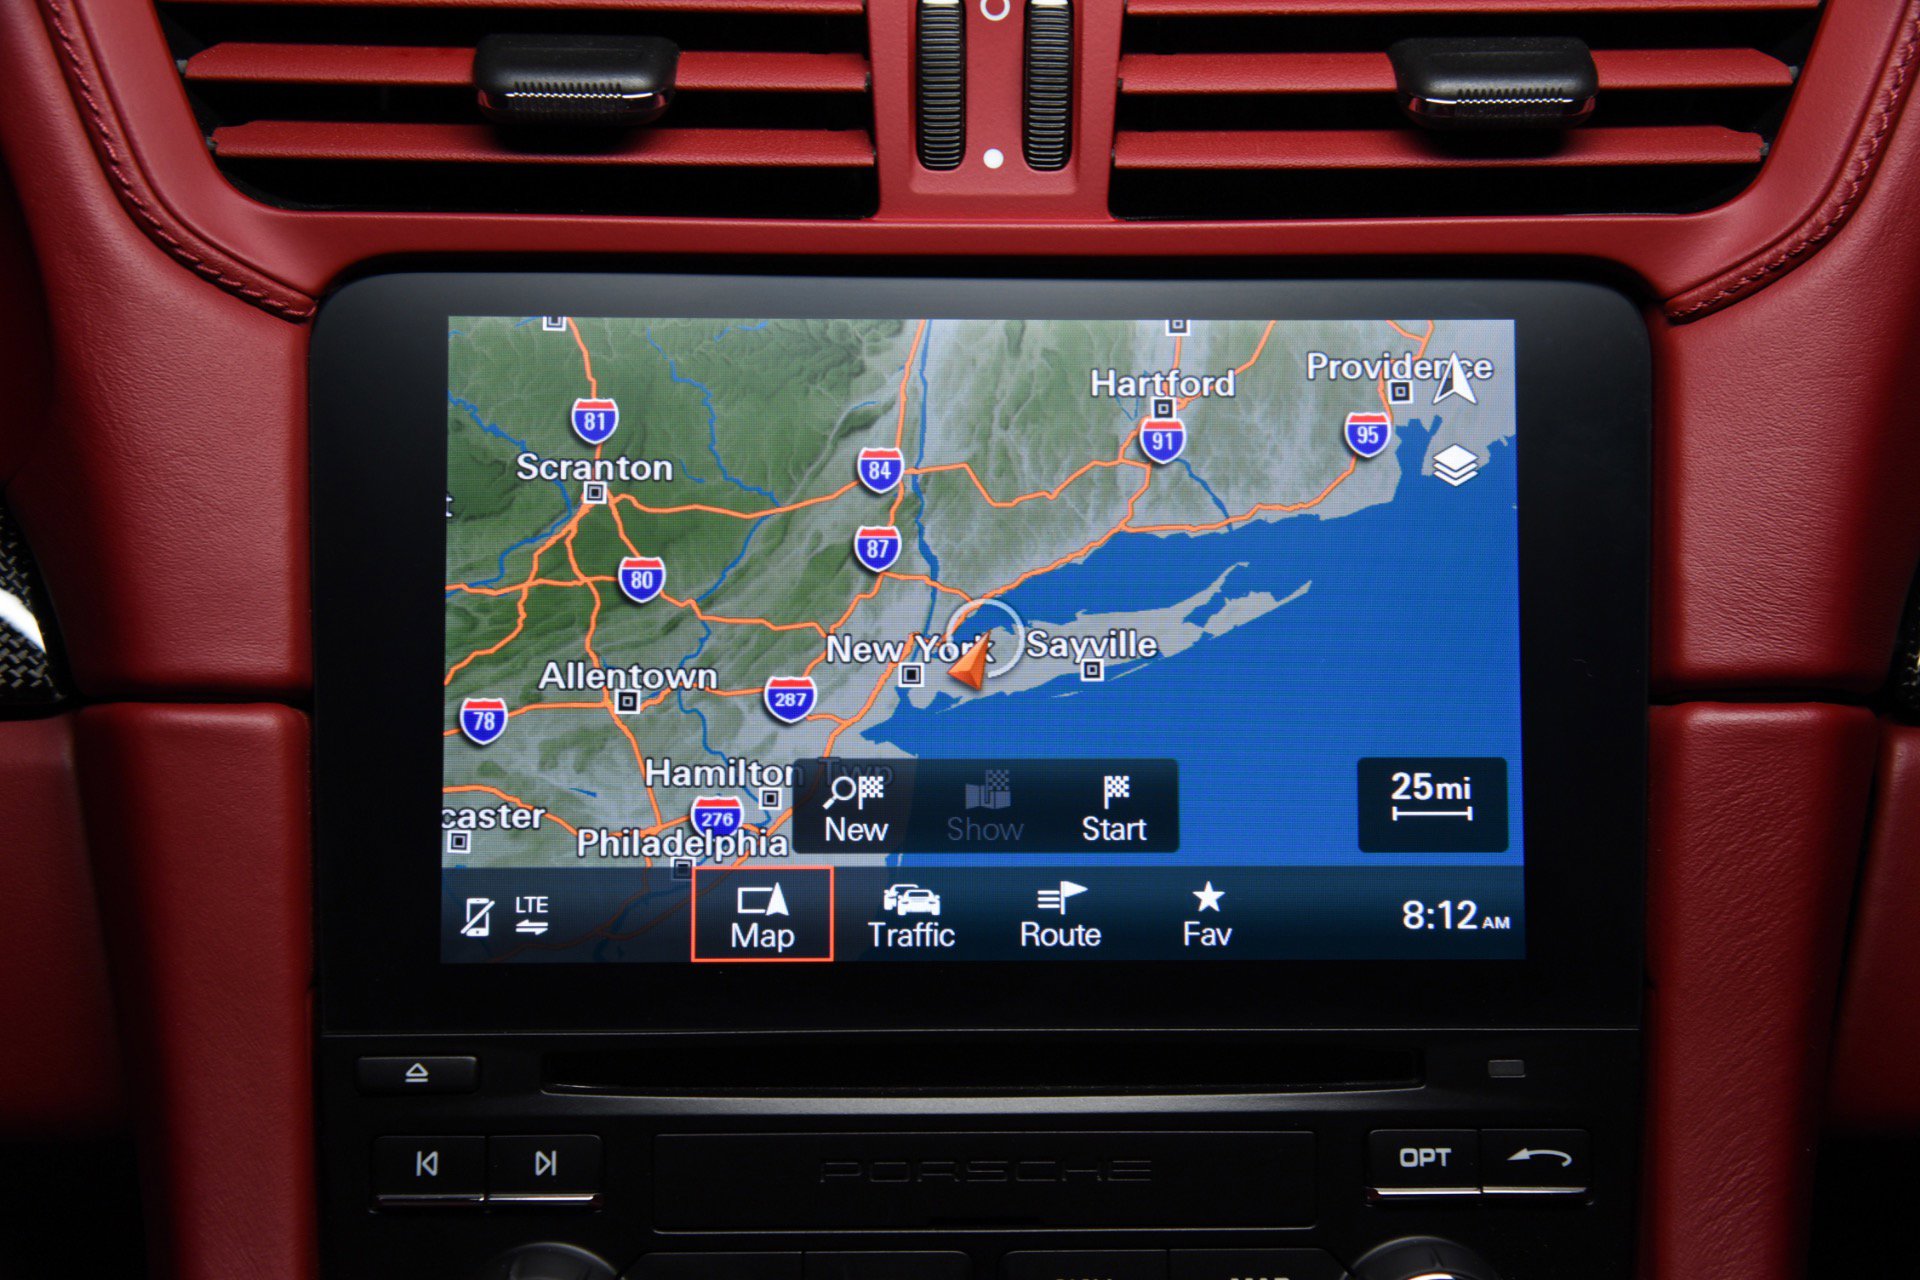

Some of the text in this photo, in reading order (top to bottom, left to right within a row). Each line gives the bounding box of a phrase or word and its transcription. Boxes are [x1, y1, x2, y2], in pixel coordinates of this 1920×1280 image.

[1307, 351, 1493, 380] Providence
[1091, 368, 1236, 397] Hartford
[584, 412, 606, 431] 81
[1356, 426, 1379, 444] 95
[1151, 432, 1174, 451] 91
[517, 452, 674, 481] Scranton
[868, 461, 891, 480] 84
[866, 540, 889, 558] 87
[630, 571, 653, 589] 80
[826, 634, 905, 663] New
[1026, 629, 1158, 663] Sayville
[538, 661, 718, 690] Allentown
[774, 692, 807, 708] 287
[472, 712, 496, 731] 78
[645, 758, 804, 787] Hamilton
[1390, 772, 1472, 801] 25mi
[441, 803, 547, 830] caster
[700, 811, 735, 828] 276
[824, 816, 890, 842] New
[946, 816, 1025, 842] Show
[1081, 815, 1148, 842] Start
[576, 827, 789, 862] Philadelphia
[515, 896, 549, 914] LTE
[1402, 899, 1511, 930] 8:12 AM
[730, 921, 796, 953] Map
[867, 921, 957, 948] Traffic
[1019, 920, 1102, 947] Route
[1182, 920, 1233, 947] Fav
[819, 1159, 1153, 1183] PORSCHE
[1399, 1147, 1452, 1168] OPT
